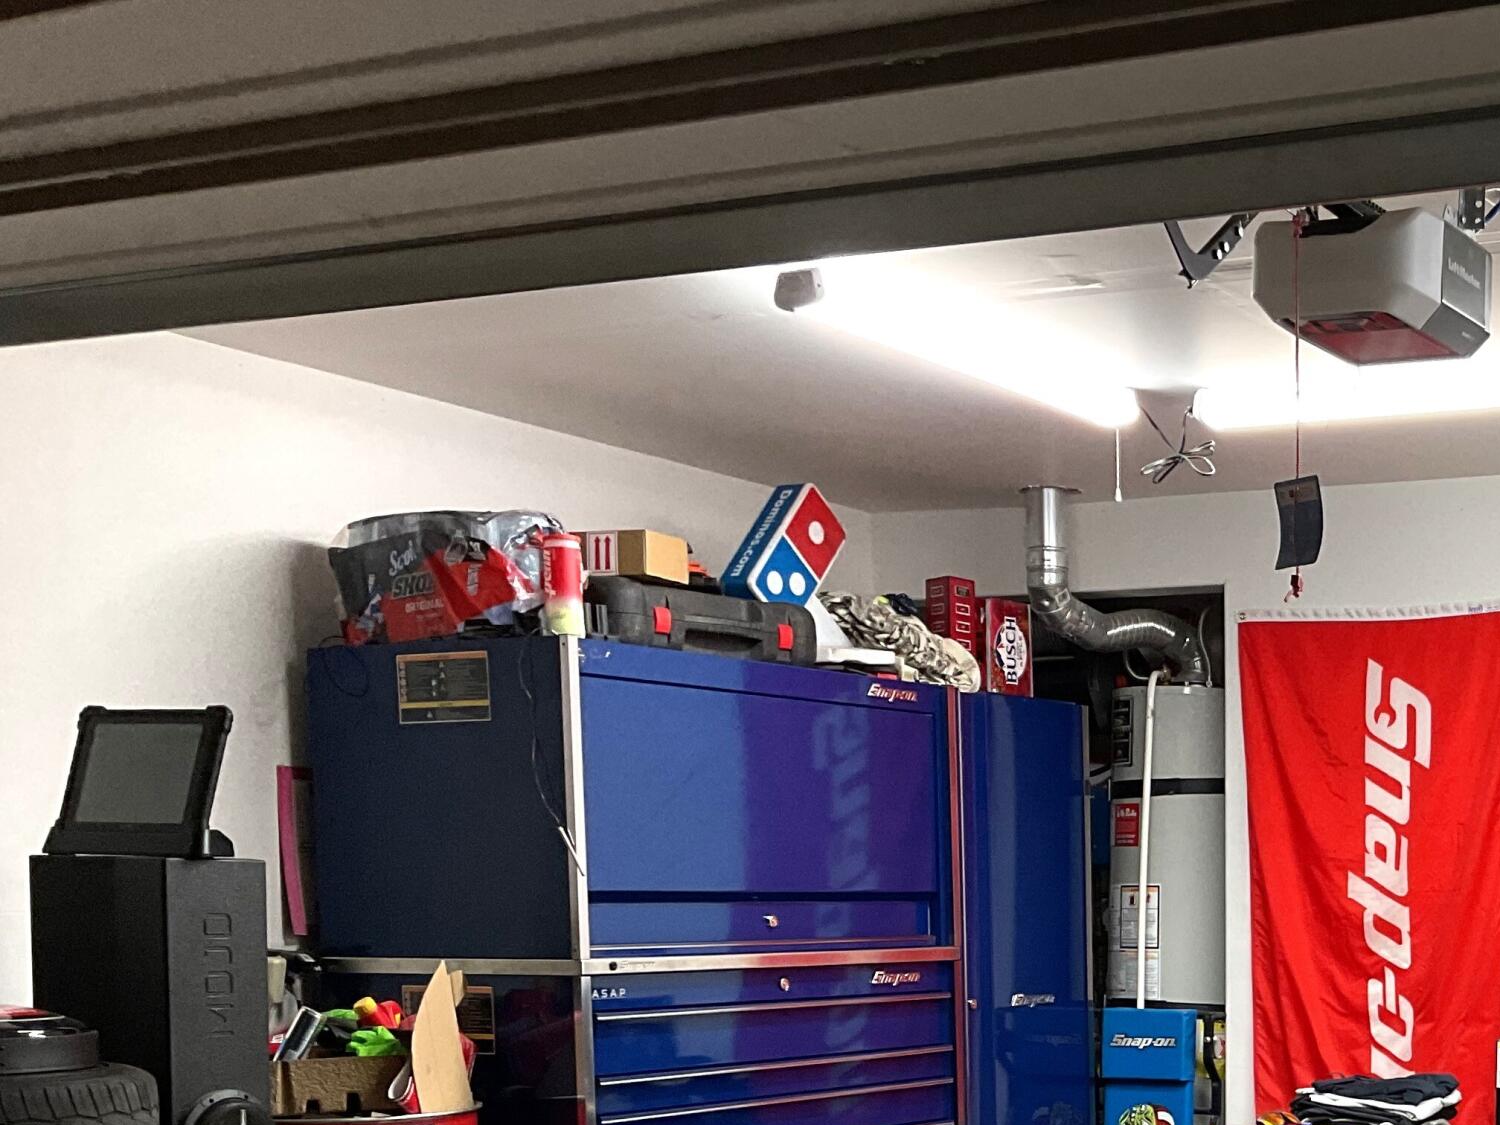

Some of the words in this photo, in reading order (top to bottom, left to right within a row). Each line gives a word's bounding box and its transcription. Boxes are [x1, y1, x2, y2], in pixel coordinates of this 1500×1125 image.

[1005, 618, 1017, 683] BUSCH
[592, 988, 626, 999] ASAP
[1110, 1034, 1176, 1049] Snap-on
